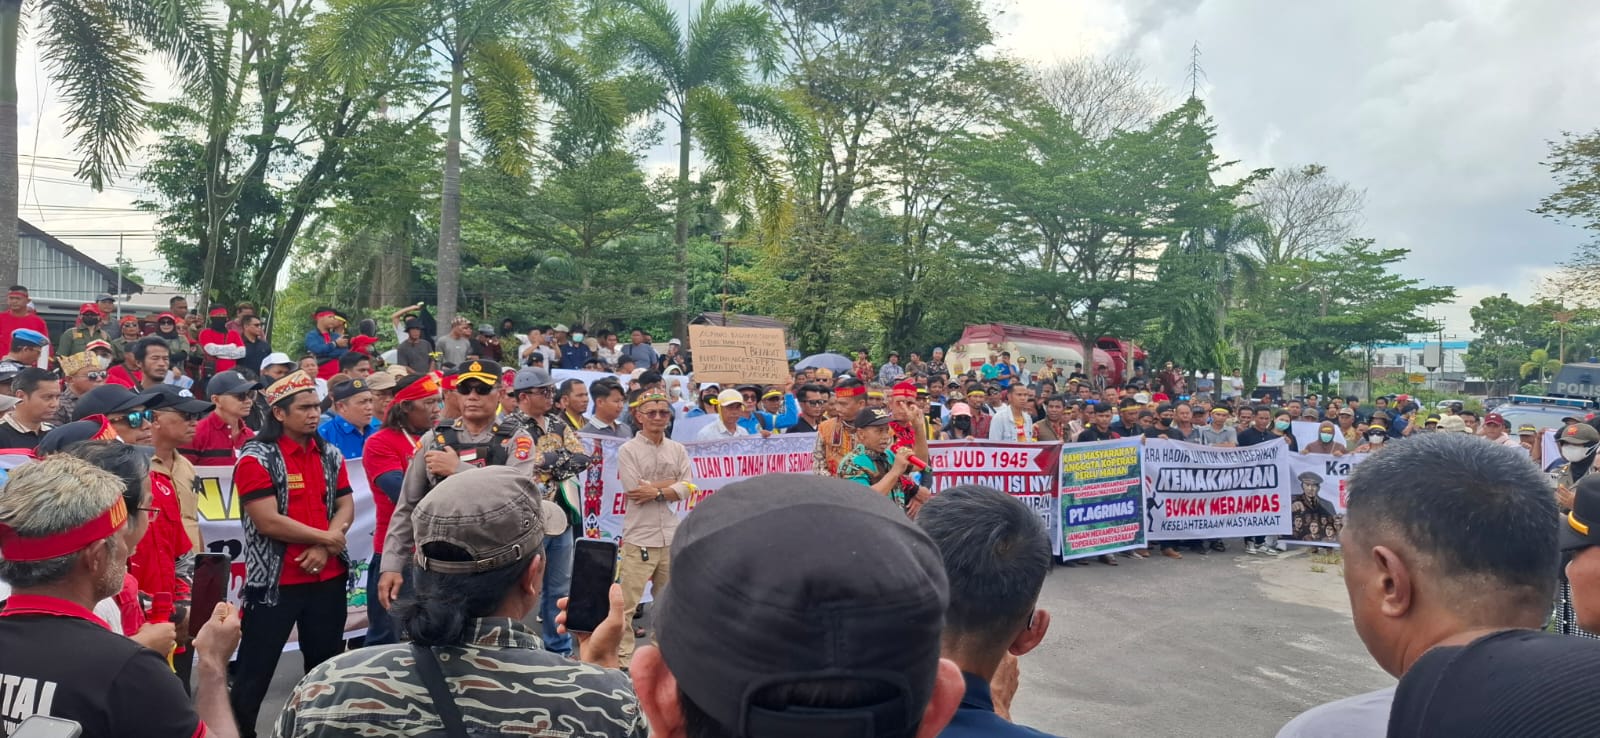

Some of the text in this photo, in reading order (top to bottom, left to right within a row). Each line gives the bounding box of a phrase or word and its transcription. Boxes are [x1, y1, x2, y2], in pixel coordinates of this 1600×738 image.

[953, 450, 985, 468] UUD
[991, 451, 1028, 468] 1945
[1101, 456, 1138, 468] KOPERASI
[1144, 448, 1160, 463] ARA
[1162, 448, 1190, 463] HADIR
[1190, 449, 1220, 464] UNTUK
[693, 455, 722, 478] TUAN
[724, 456, 735, 477] DI
[737, 454, 764, 476] TANAH
[766, 453, 786, 474] KAMI
[1325, 460, 1354, 476] Ka
[1008, 475, 1025, 493] ISI
[1069, 500, 1135, 524] PT.AGRINAS
[1165, 494, 1280, 518] BUKAN MERAMPAS
[1160, 515, 1281, 531] KESEJAHTERAAN MASYARAKAT
